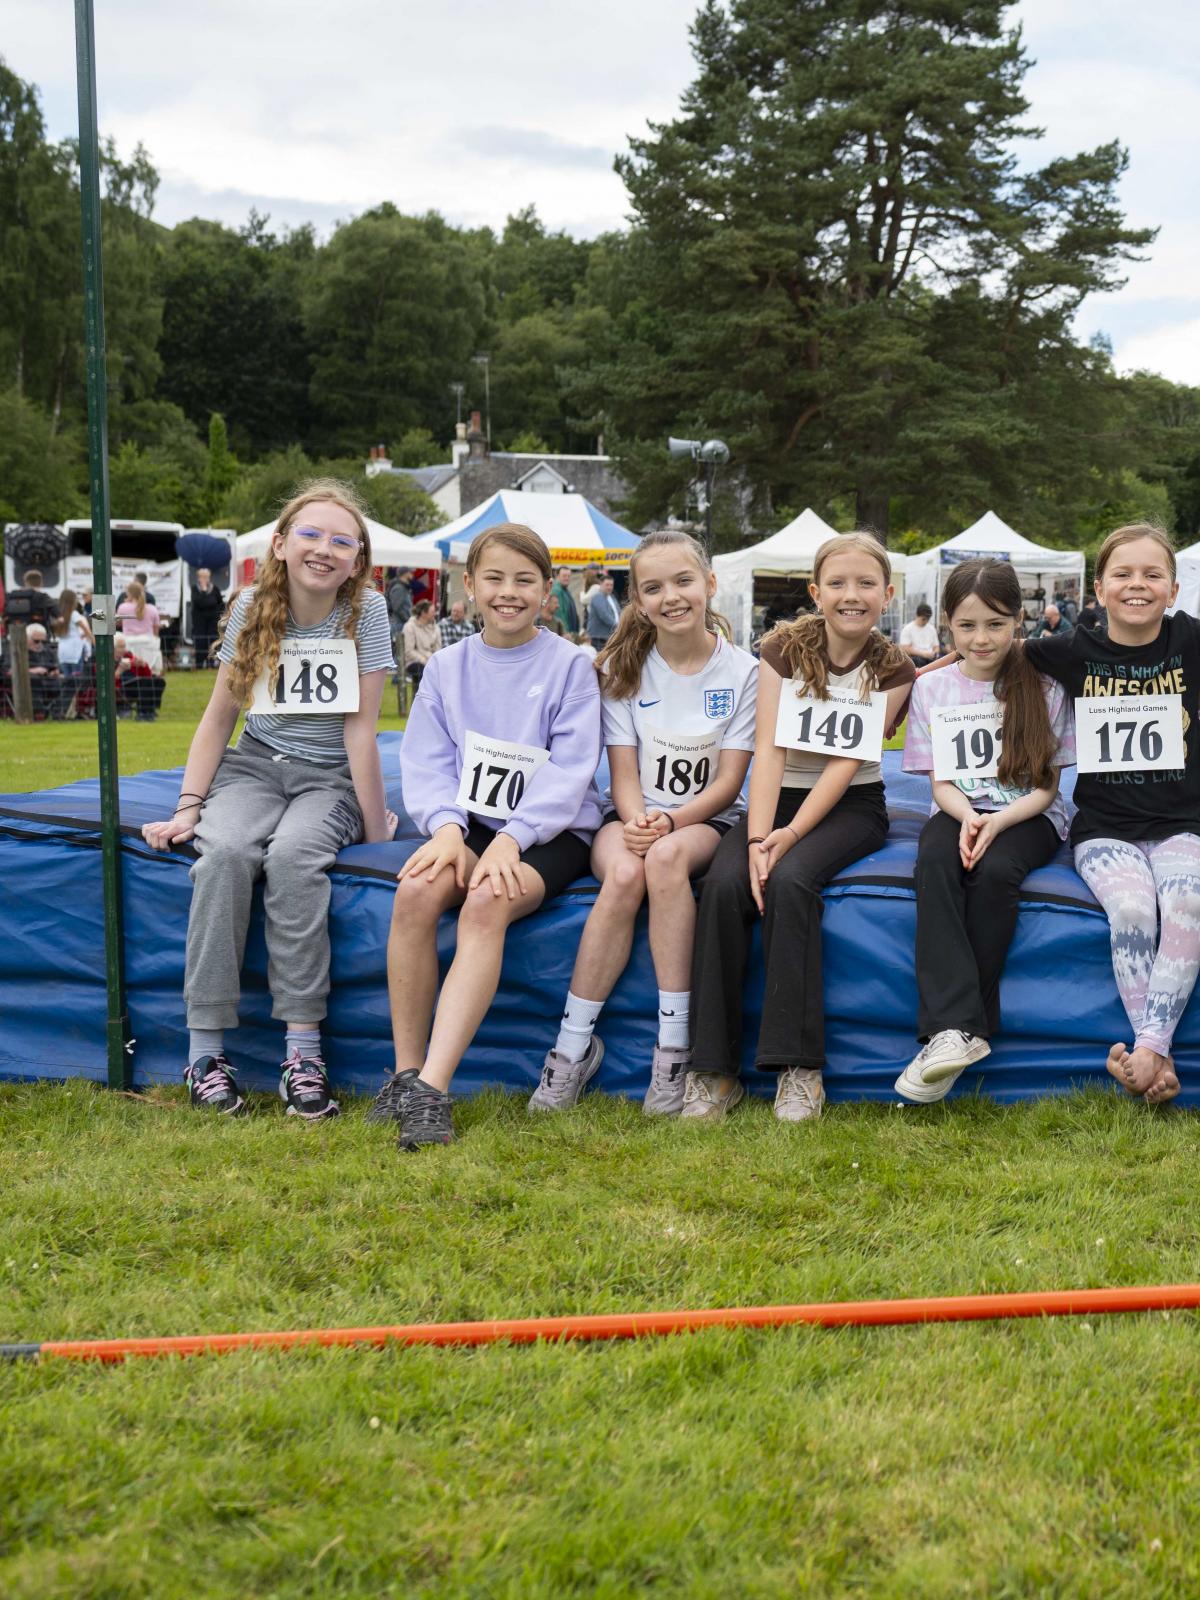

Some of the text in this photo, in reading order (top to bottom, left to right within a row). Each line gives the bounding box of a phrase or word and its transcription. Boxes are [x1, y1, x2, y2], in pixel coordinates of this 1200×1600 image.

[284, 648, 317, 656] Highland
[1085, 661, 1112, 676] THIS
[1115, 665, 1127, 678] IS
[1131, 662, 1165, 679] WHAT
[274, 664, 338, 703] 148
[1083, 668, 1186, 697] AWESOME
[963, 712, 995, 721] Highland
[1108, 705, 1140, 714] Highland
[797, 706, 863, 750] 149
[653, 736, 666, 747] Luss
[668, 741, 699, 752] Highland
[1095, 720, 1163, 762] 176
[473, 744, 535, 763] Luss Highland Games
[468, 762, 524, 810] 170
[654, 755, 710, 796] 189
